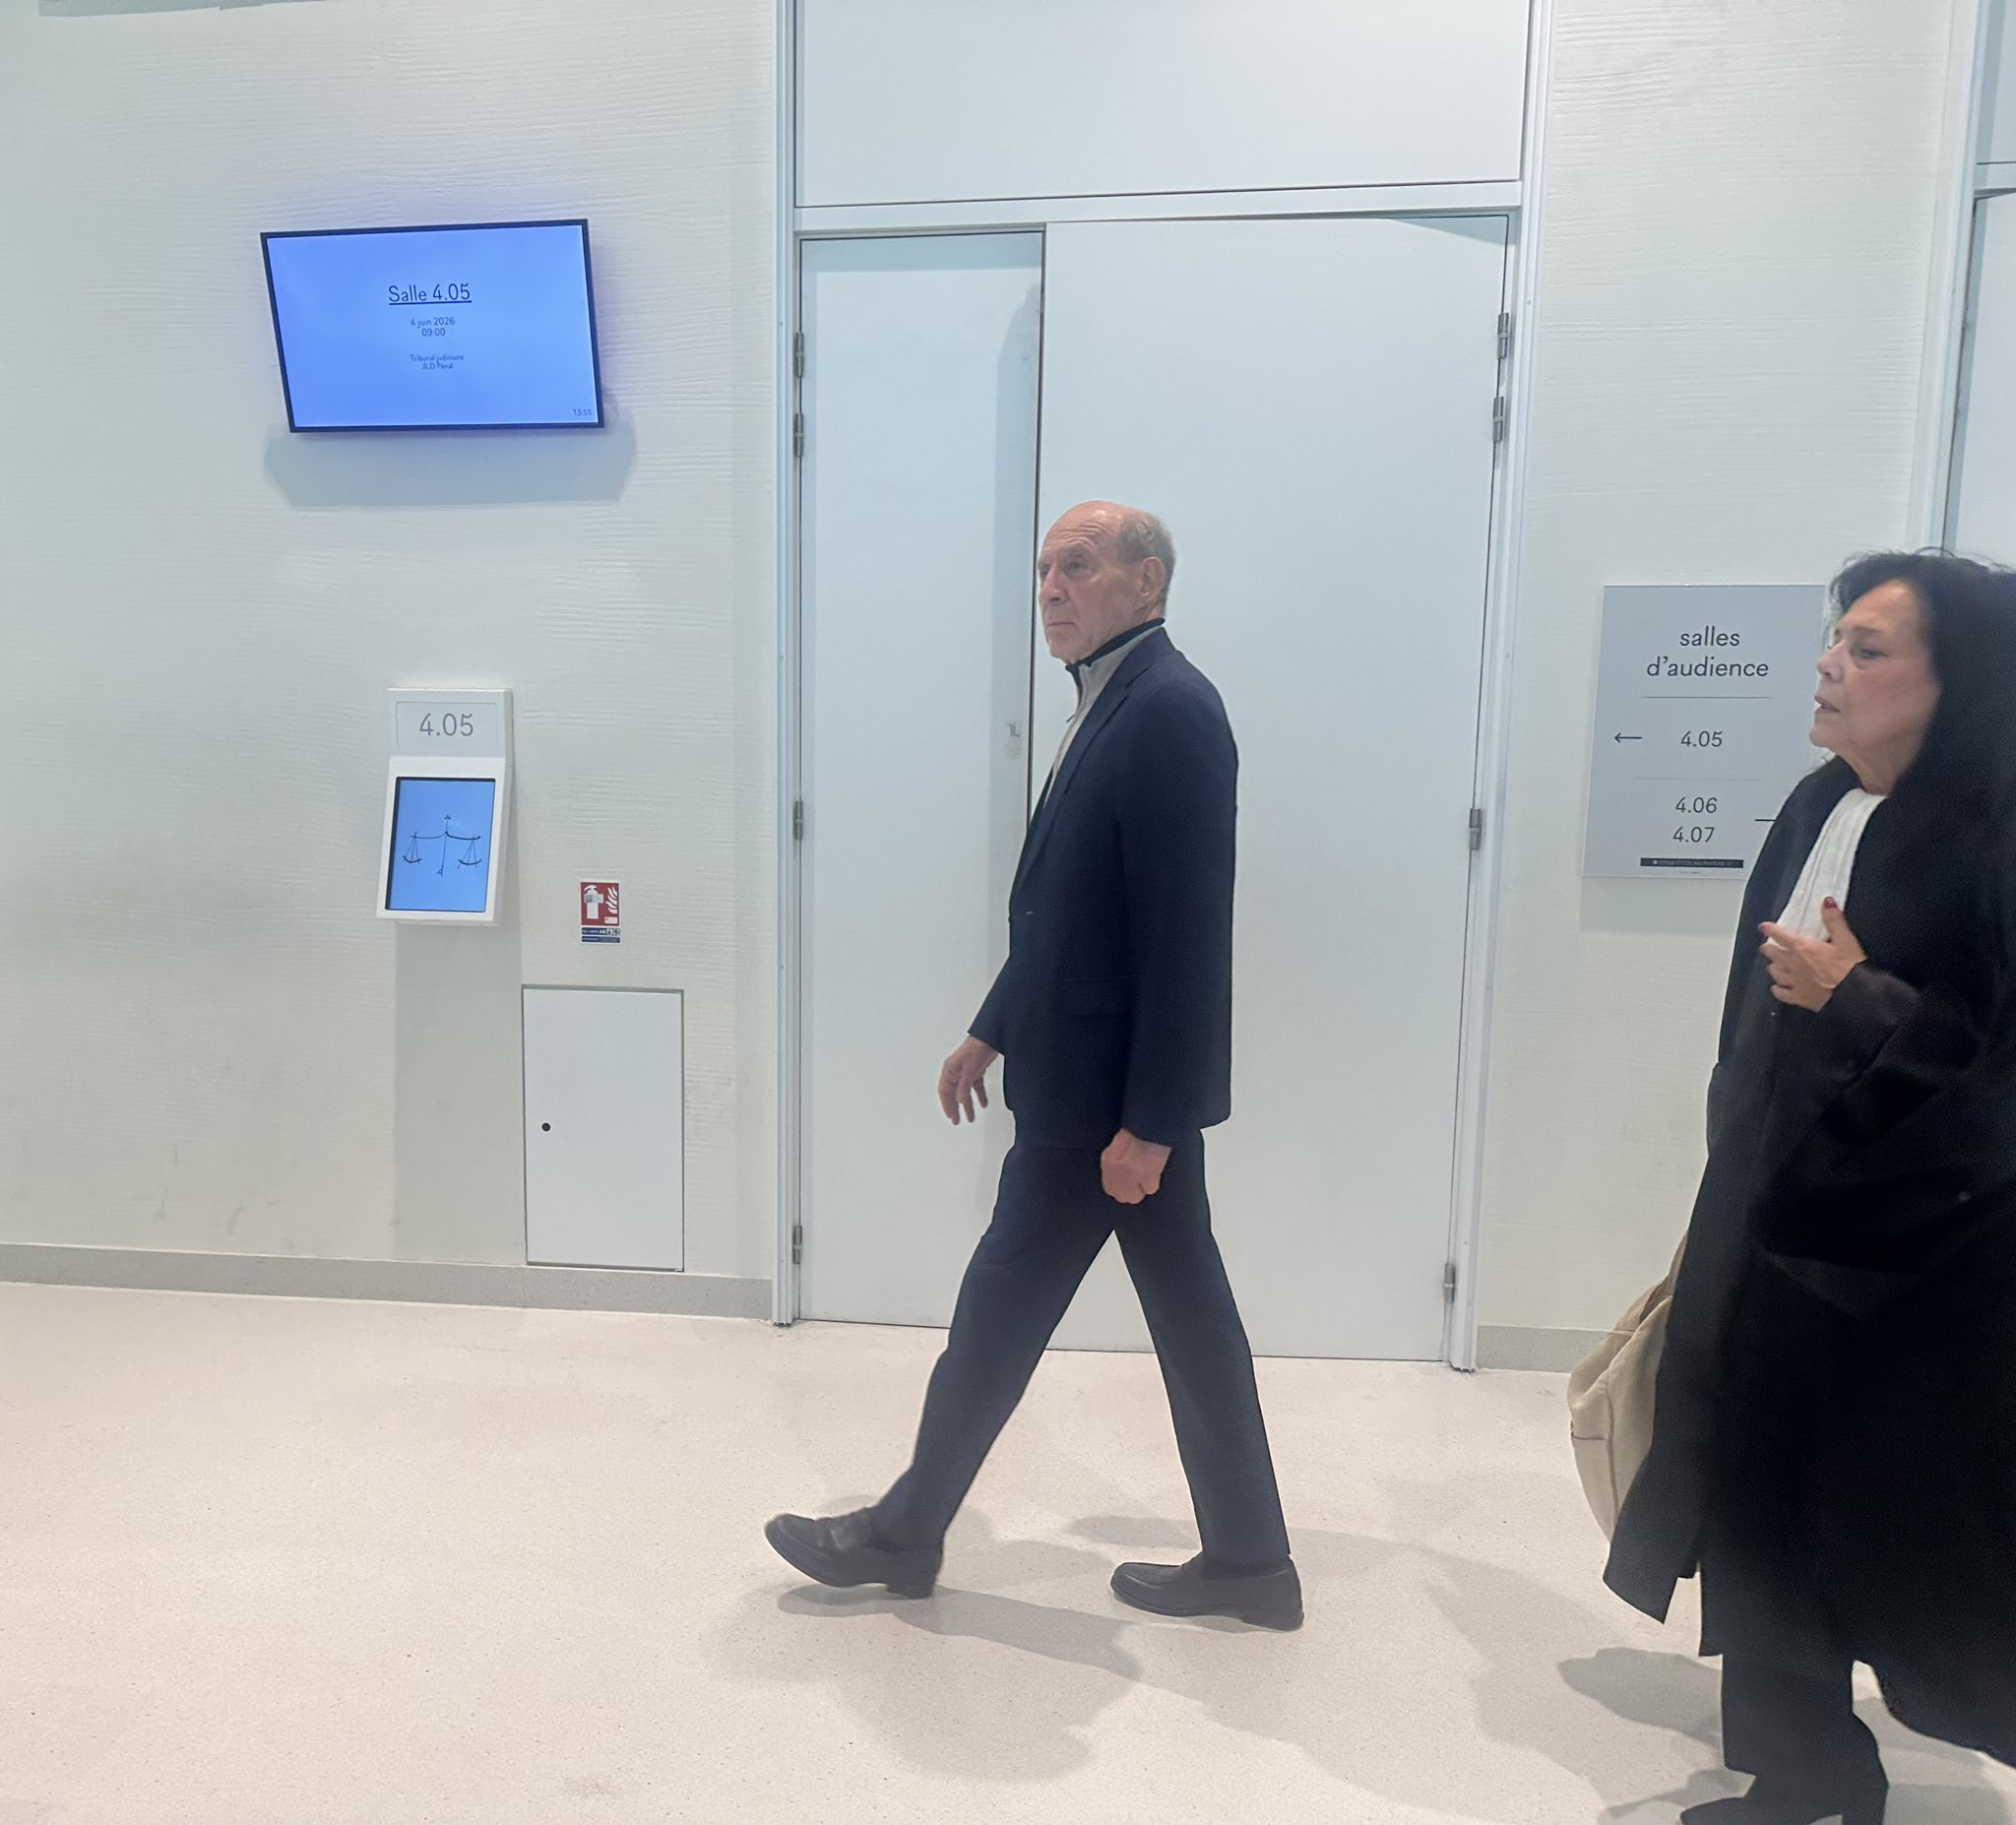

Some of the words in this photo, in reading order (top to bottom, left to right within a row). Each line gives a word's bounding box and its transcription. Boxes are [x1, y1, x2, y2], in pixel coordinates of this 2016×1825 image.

[389, 284, 427, 302] Salle
[433, 283, 471, 301] 4.05
[410, 317, 415, 326] 4
[417, 318, 432, 329] juin
[433, 316, 456, 326] 2026
[421, 328, 446, 337] 09:00
[410, 353, 435, 362] Tribunal
[1679, 625, 1740, 647] salles
[1646, 656, 1769, 677] d’audience
[419, 713, 473, 736] 4.05
[1680, 730, 1723, 748] 4.05
[1674, 796, 1718, 814] 4.06
[1672, 826, 1715, 844] 4.07
